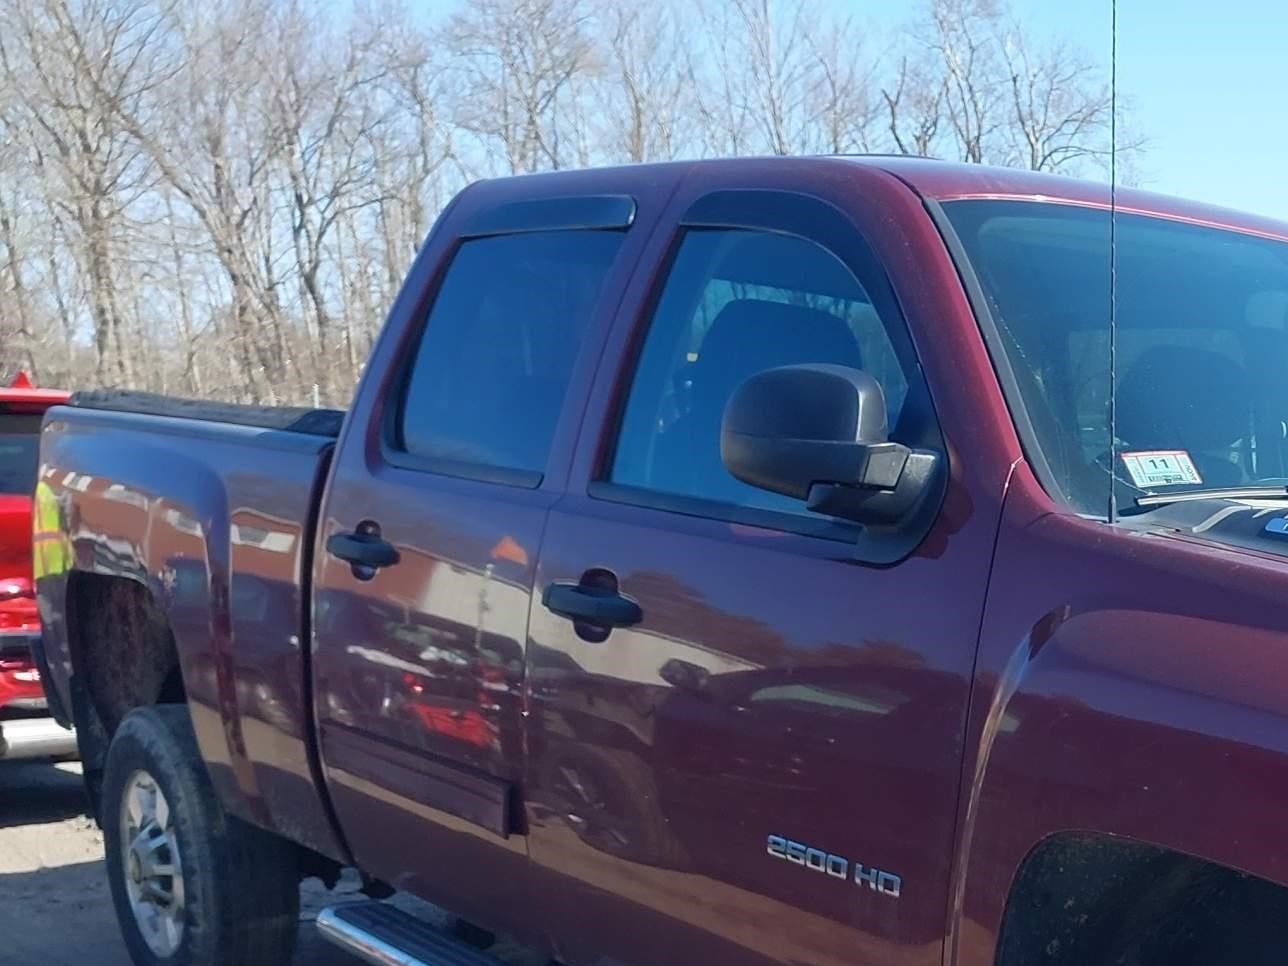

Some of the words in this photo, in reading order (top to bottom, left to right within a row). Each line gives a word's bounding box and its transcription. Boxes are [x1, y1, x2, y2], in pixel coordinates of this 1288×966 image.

[1148, 458, 1169, 470] 11
[767, 833, 849, 880] 2500
[854, 861, 903, 898] HD
